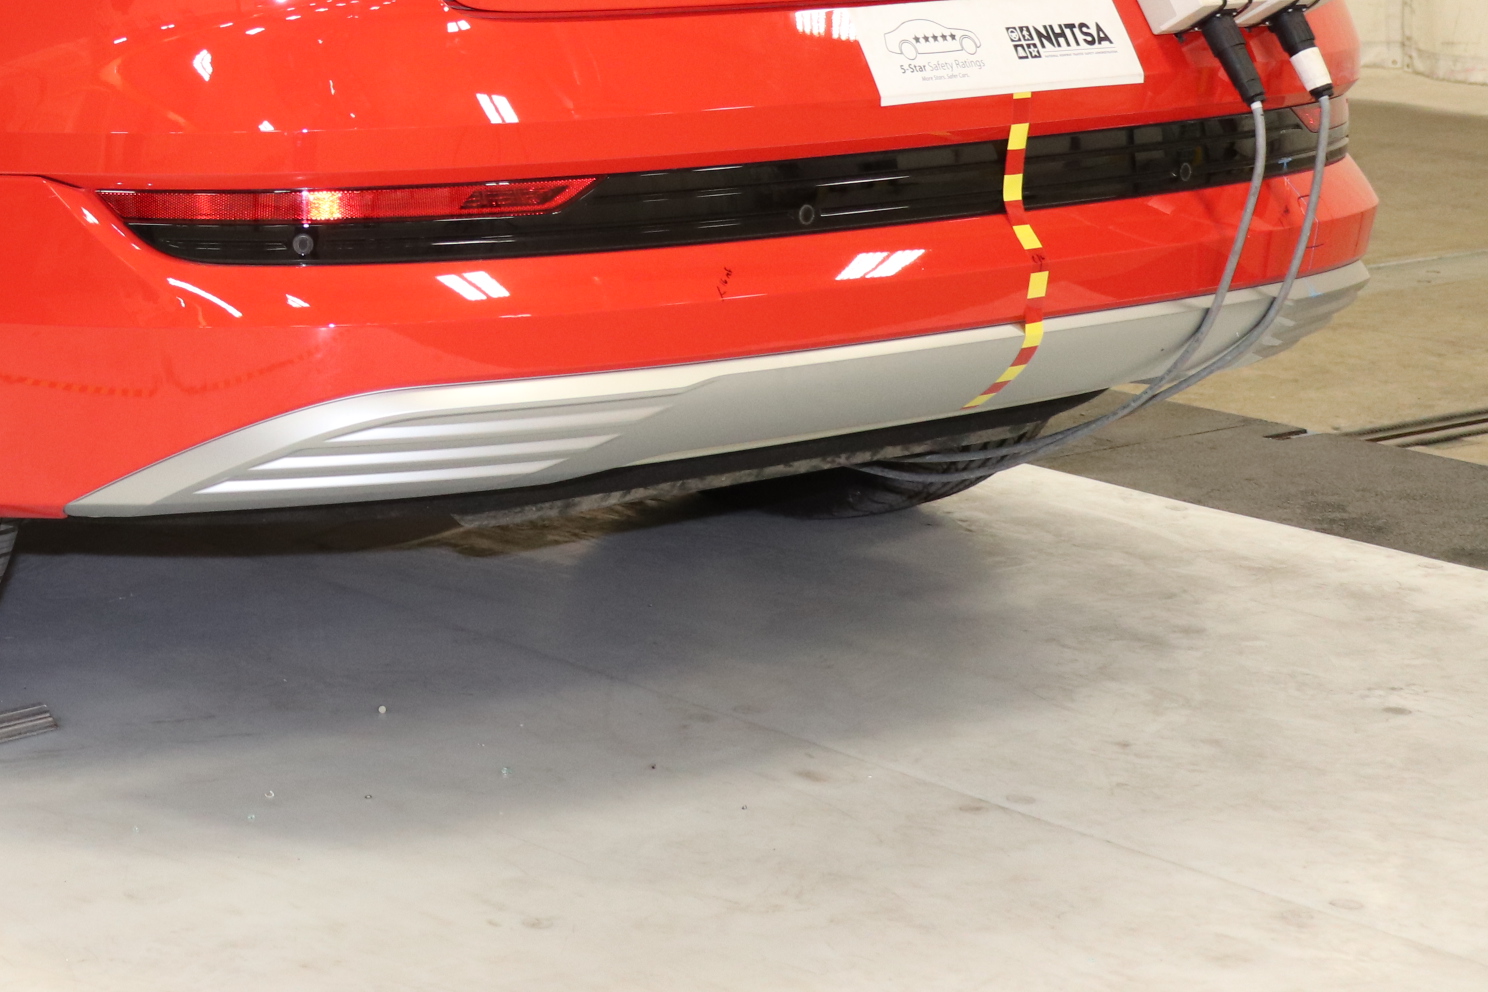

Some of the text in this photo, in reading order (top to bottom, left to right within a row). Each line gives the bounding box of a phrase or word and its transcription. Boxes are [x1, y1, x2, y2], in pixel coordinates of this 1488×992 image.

[1032, 21, 1114, 49] NHTSA
[899, 58, 986, 74] 5-Star Safety Ratings
